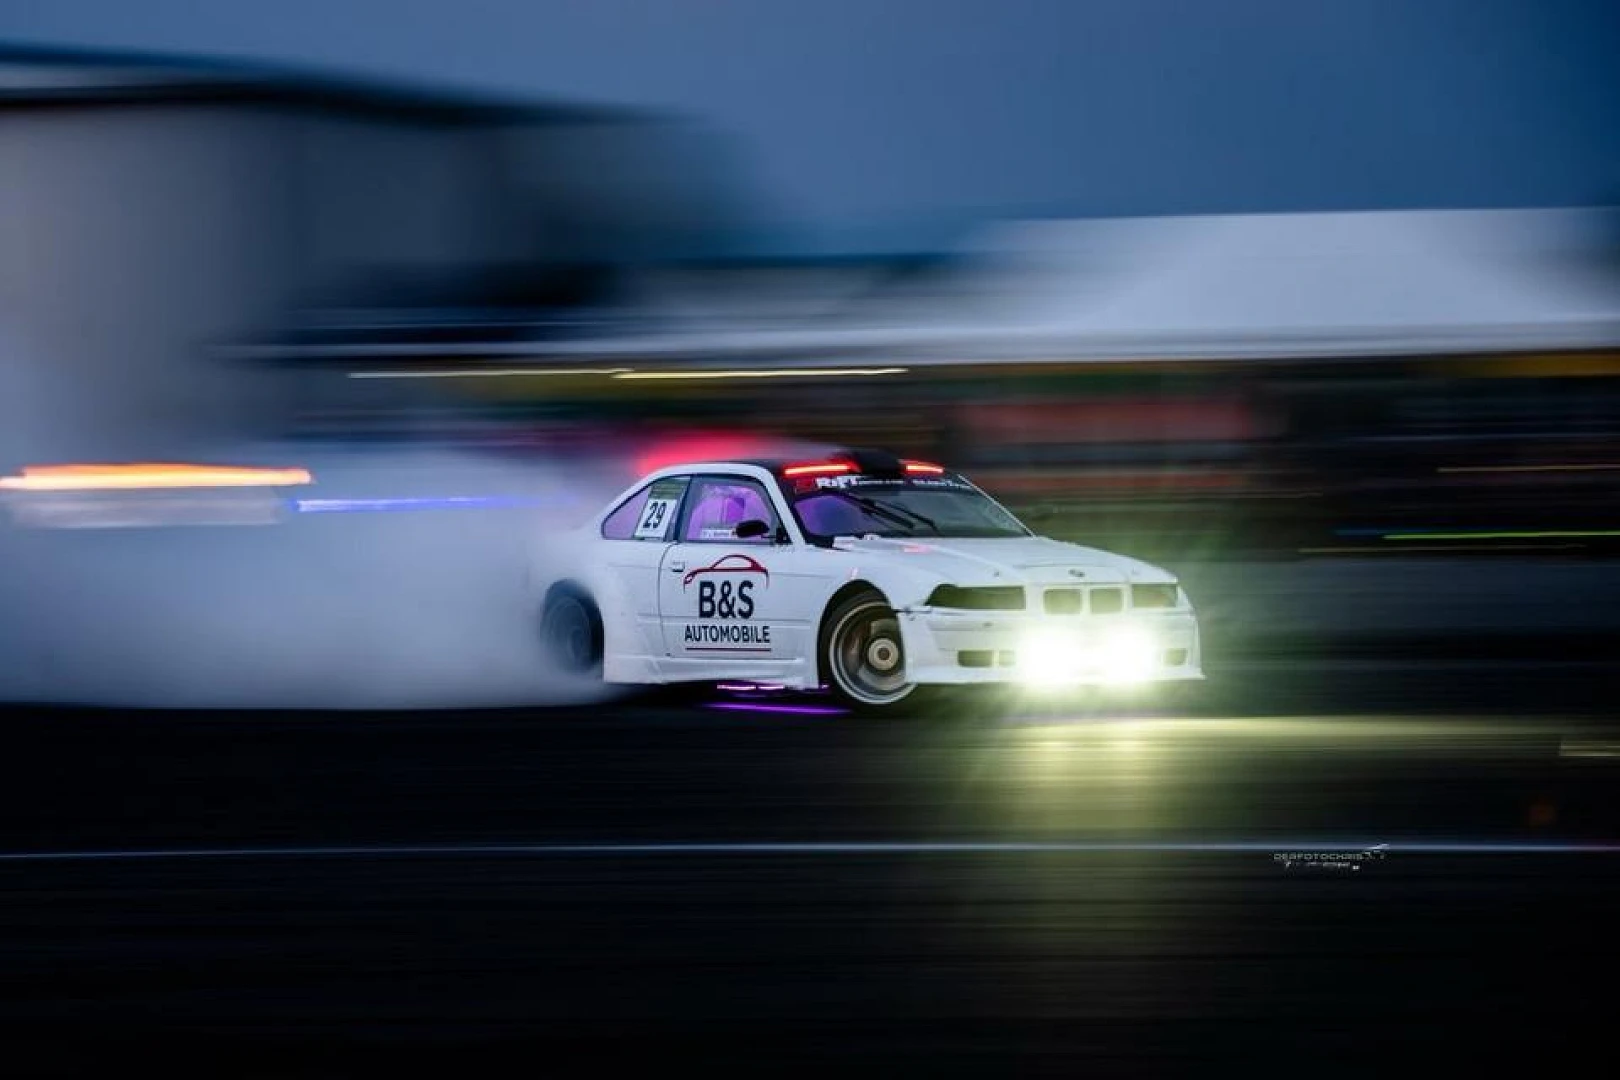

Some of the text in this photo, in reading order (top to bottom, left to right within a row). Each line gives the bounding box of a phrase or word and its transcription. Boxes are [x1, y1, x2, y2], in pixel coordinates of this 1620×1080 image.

[642, 500, 667, 529] 29
[699, 580, 754, 619] B&S
[684, 625, 771, 643] AUTOMOBILE
